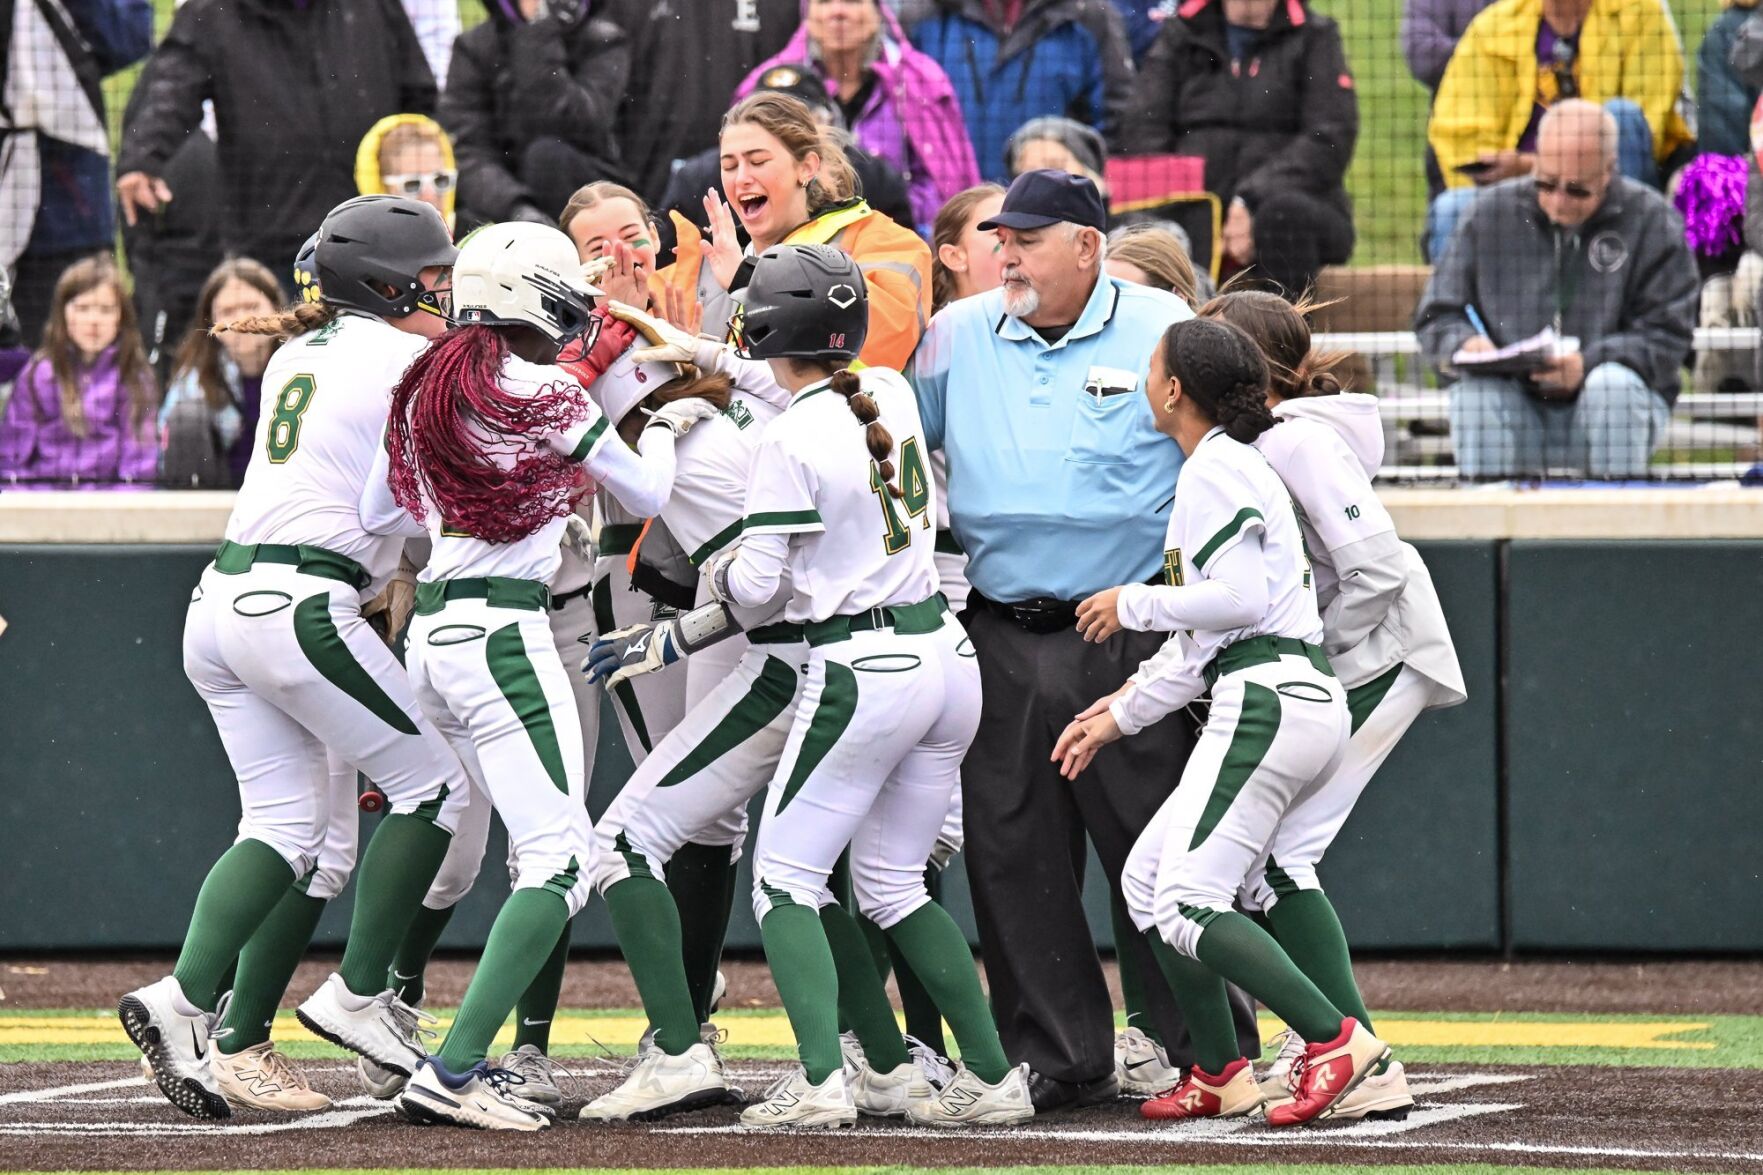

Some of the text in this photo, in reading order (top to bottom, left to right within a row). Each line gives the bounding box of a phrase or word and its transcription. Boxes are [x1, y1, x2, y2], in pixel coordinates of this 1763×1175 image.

[829, 333, 845, 348] 14
[635, 367, 648, 384] 6
[266, 373, 317, 464] 8
[869, 435, 931, 556] 14
[1344, 504, 1361, 521] 10
